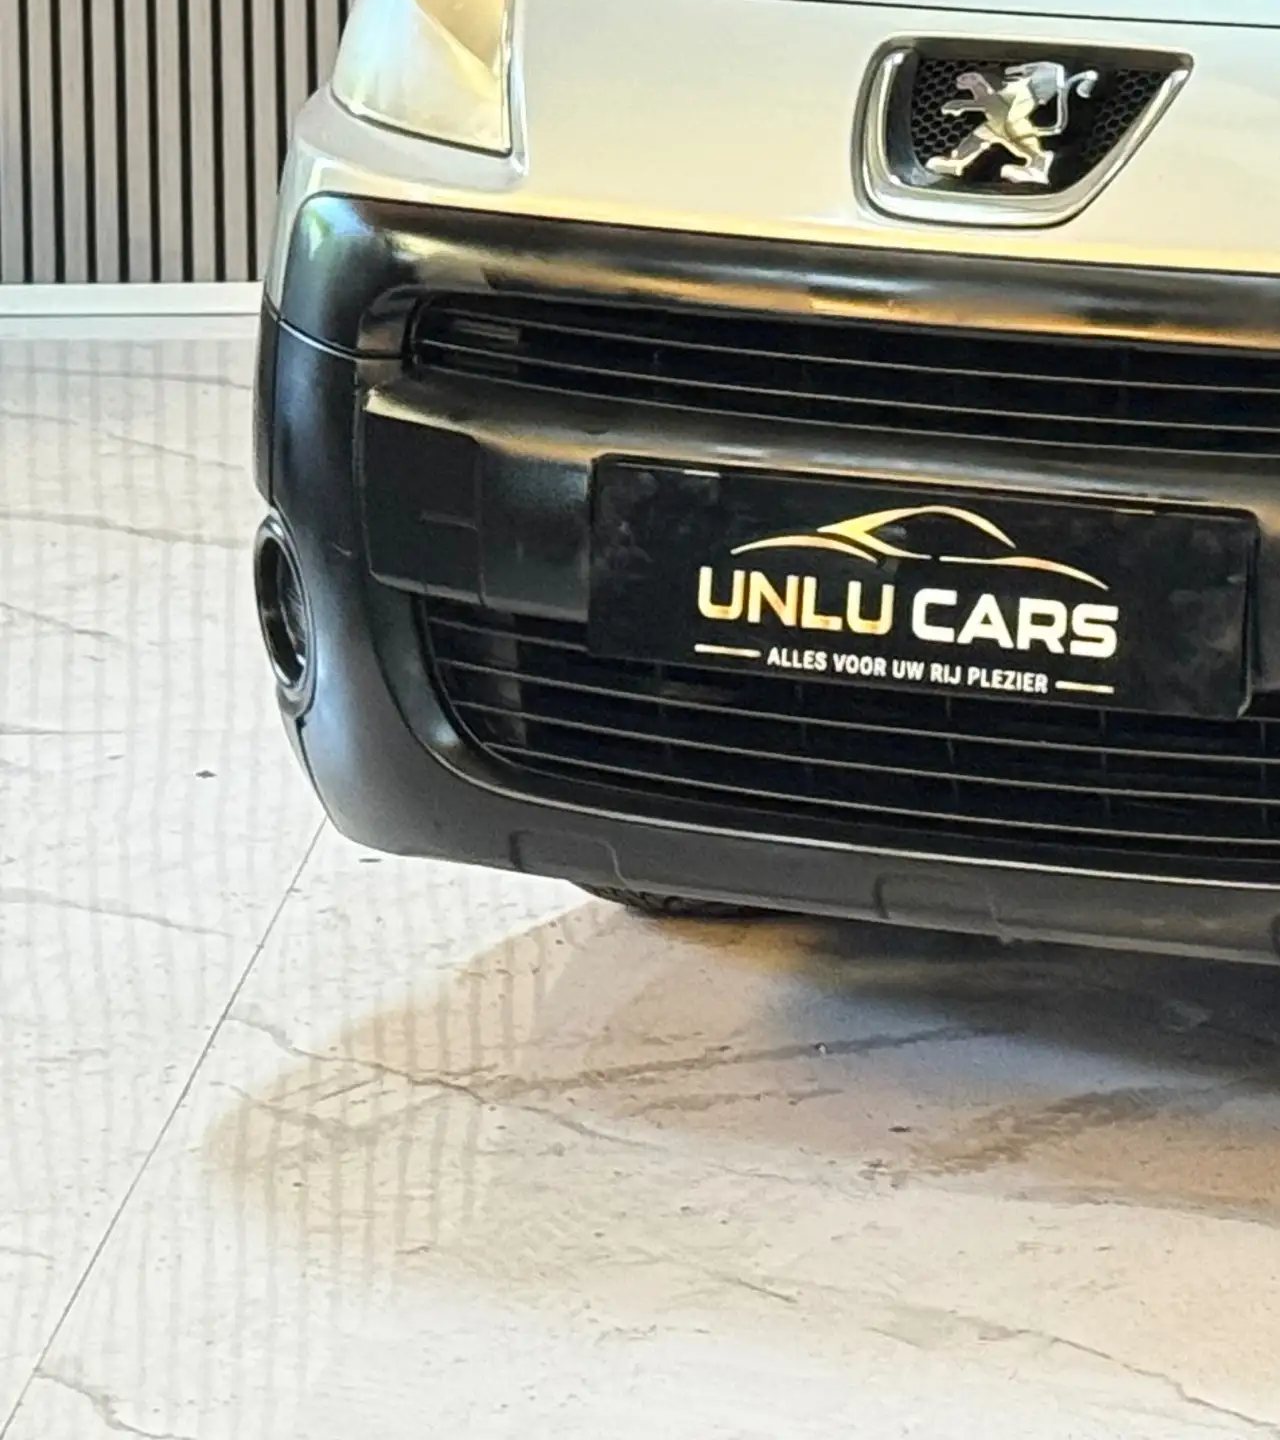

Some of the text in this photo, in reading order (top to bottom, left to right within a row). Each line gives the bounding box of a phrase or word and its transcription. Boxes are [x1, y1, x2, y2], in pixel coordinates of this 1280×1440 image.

[697, 565, 1119, 659] UNLU CARS
[766, 646, 1049, 694] ALLES VOOR UW RIJ PLEZIER
